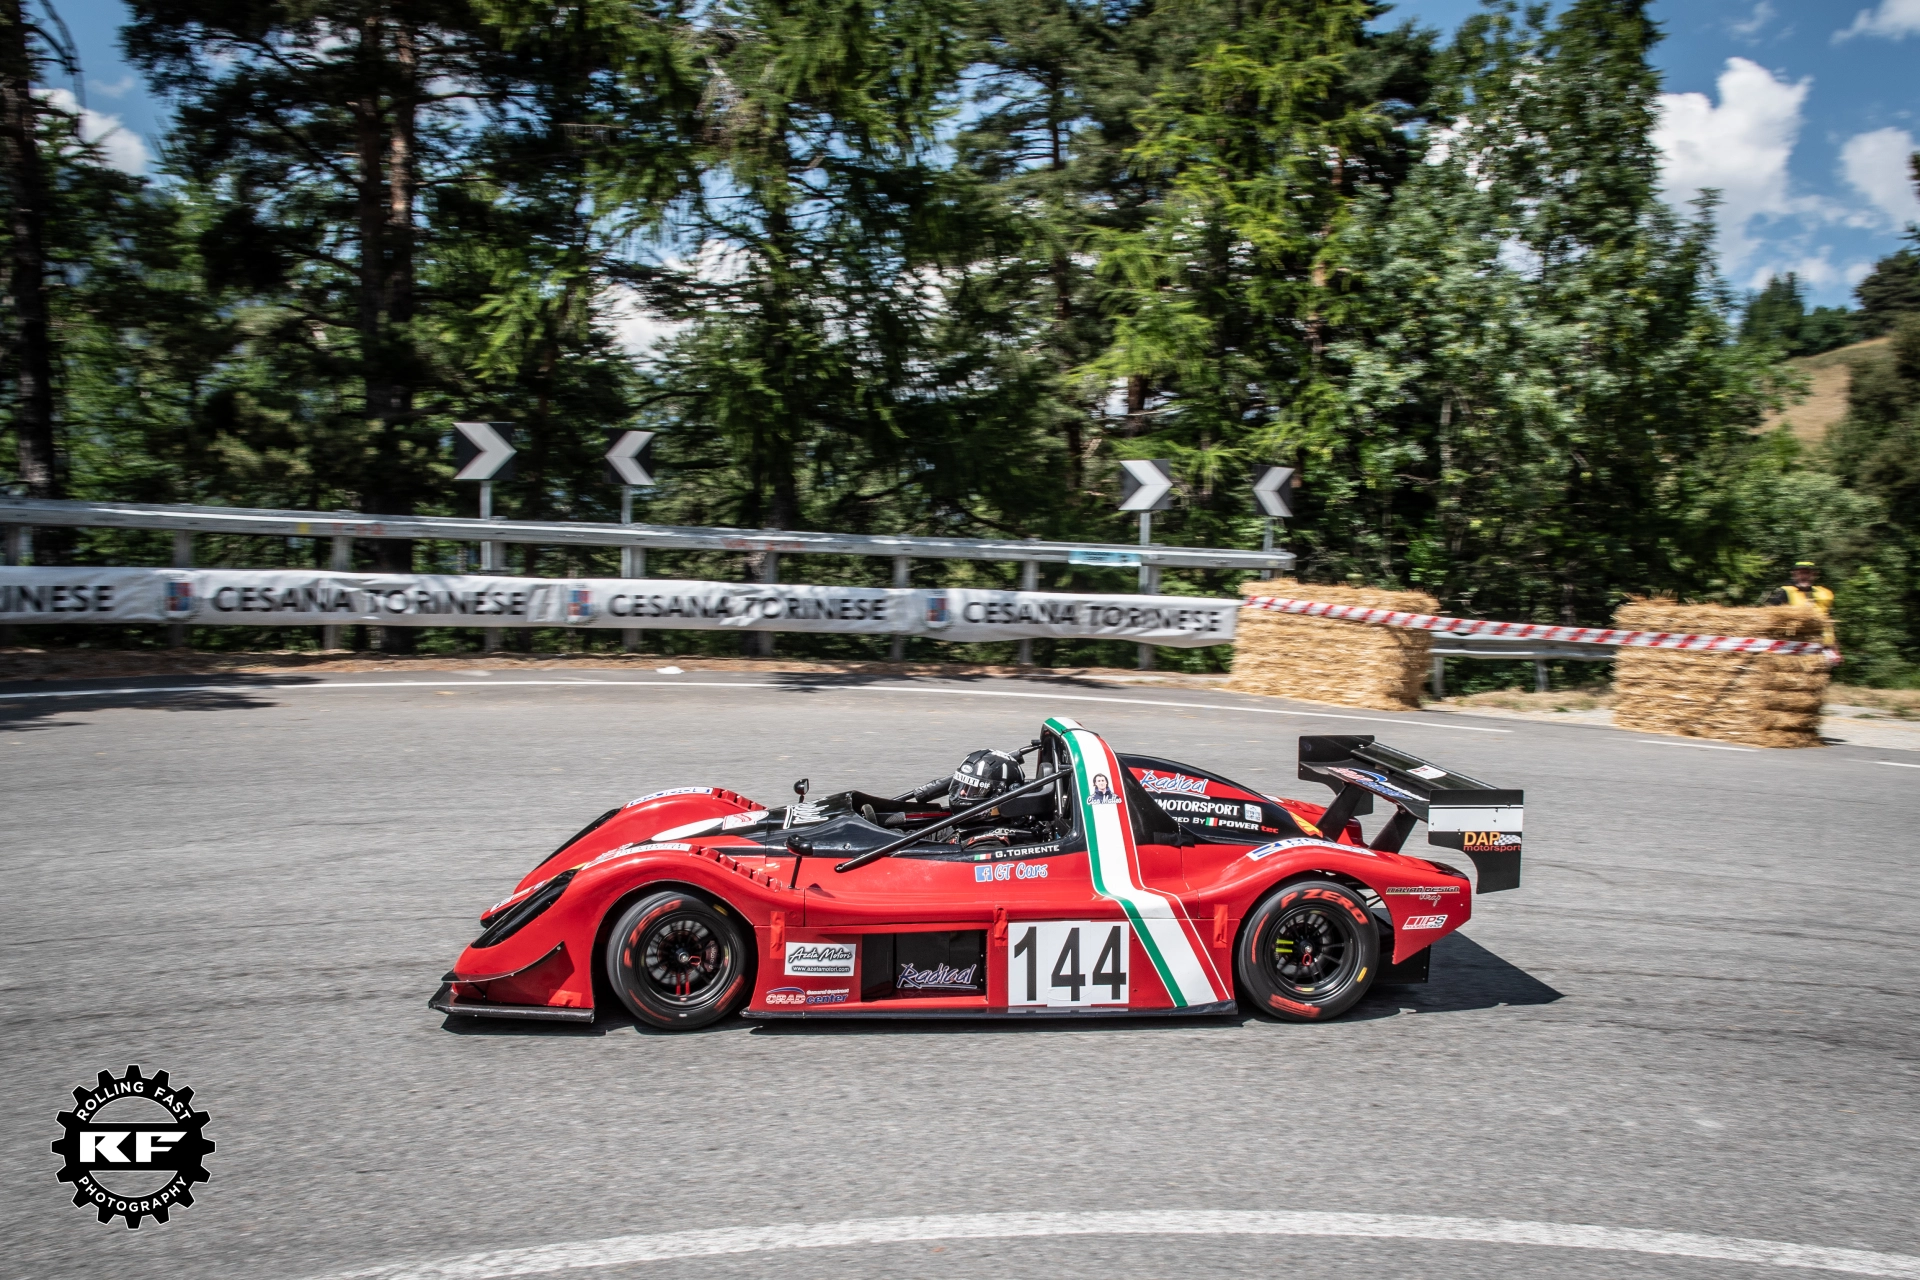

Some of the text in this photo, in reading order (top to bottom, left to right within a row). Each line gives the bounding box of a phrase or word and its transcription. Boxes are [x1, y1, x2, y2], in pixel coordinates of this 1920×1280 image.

[212, 587, 526, 615] CESANA TORINESE
[608, 594, 887, 620] CESANA TORINESE
[964, 601, 1078, 625] CESANA
[1140, 770, 1209, 793] Radical
[1218, 819, 1259, 831] POWER
[1260, 825, 1279, 834] tec
[1463, 844, 1522, 853] motorsport
[1464, 832, 1500, 846] DAP
[995, 844, 1060, 858] G.TORRENTE
[994, 864, 1014, 881] GT
[1016, 862, 1048, 879] Cars
[1281, 888, 1369, 925] P ZERO
[818, 947, 853, 962] Motori
[1014, 925, 1126, 1001] 144
[896, 963, 977, 989] Radical
[806, 993, 849, 1004] center
